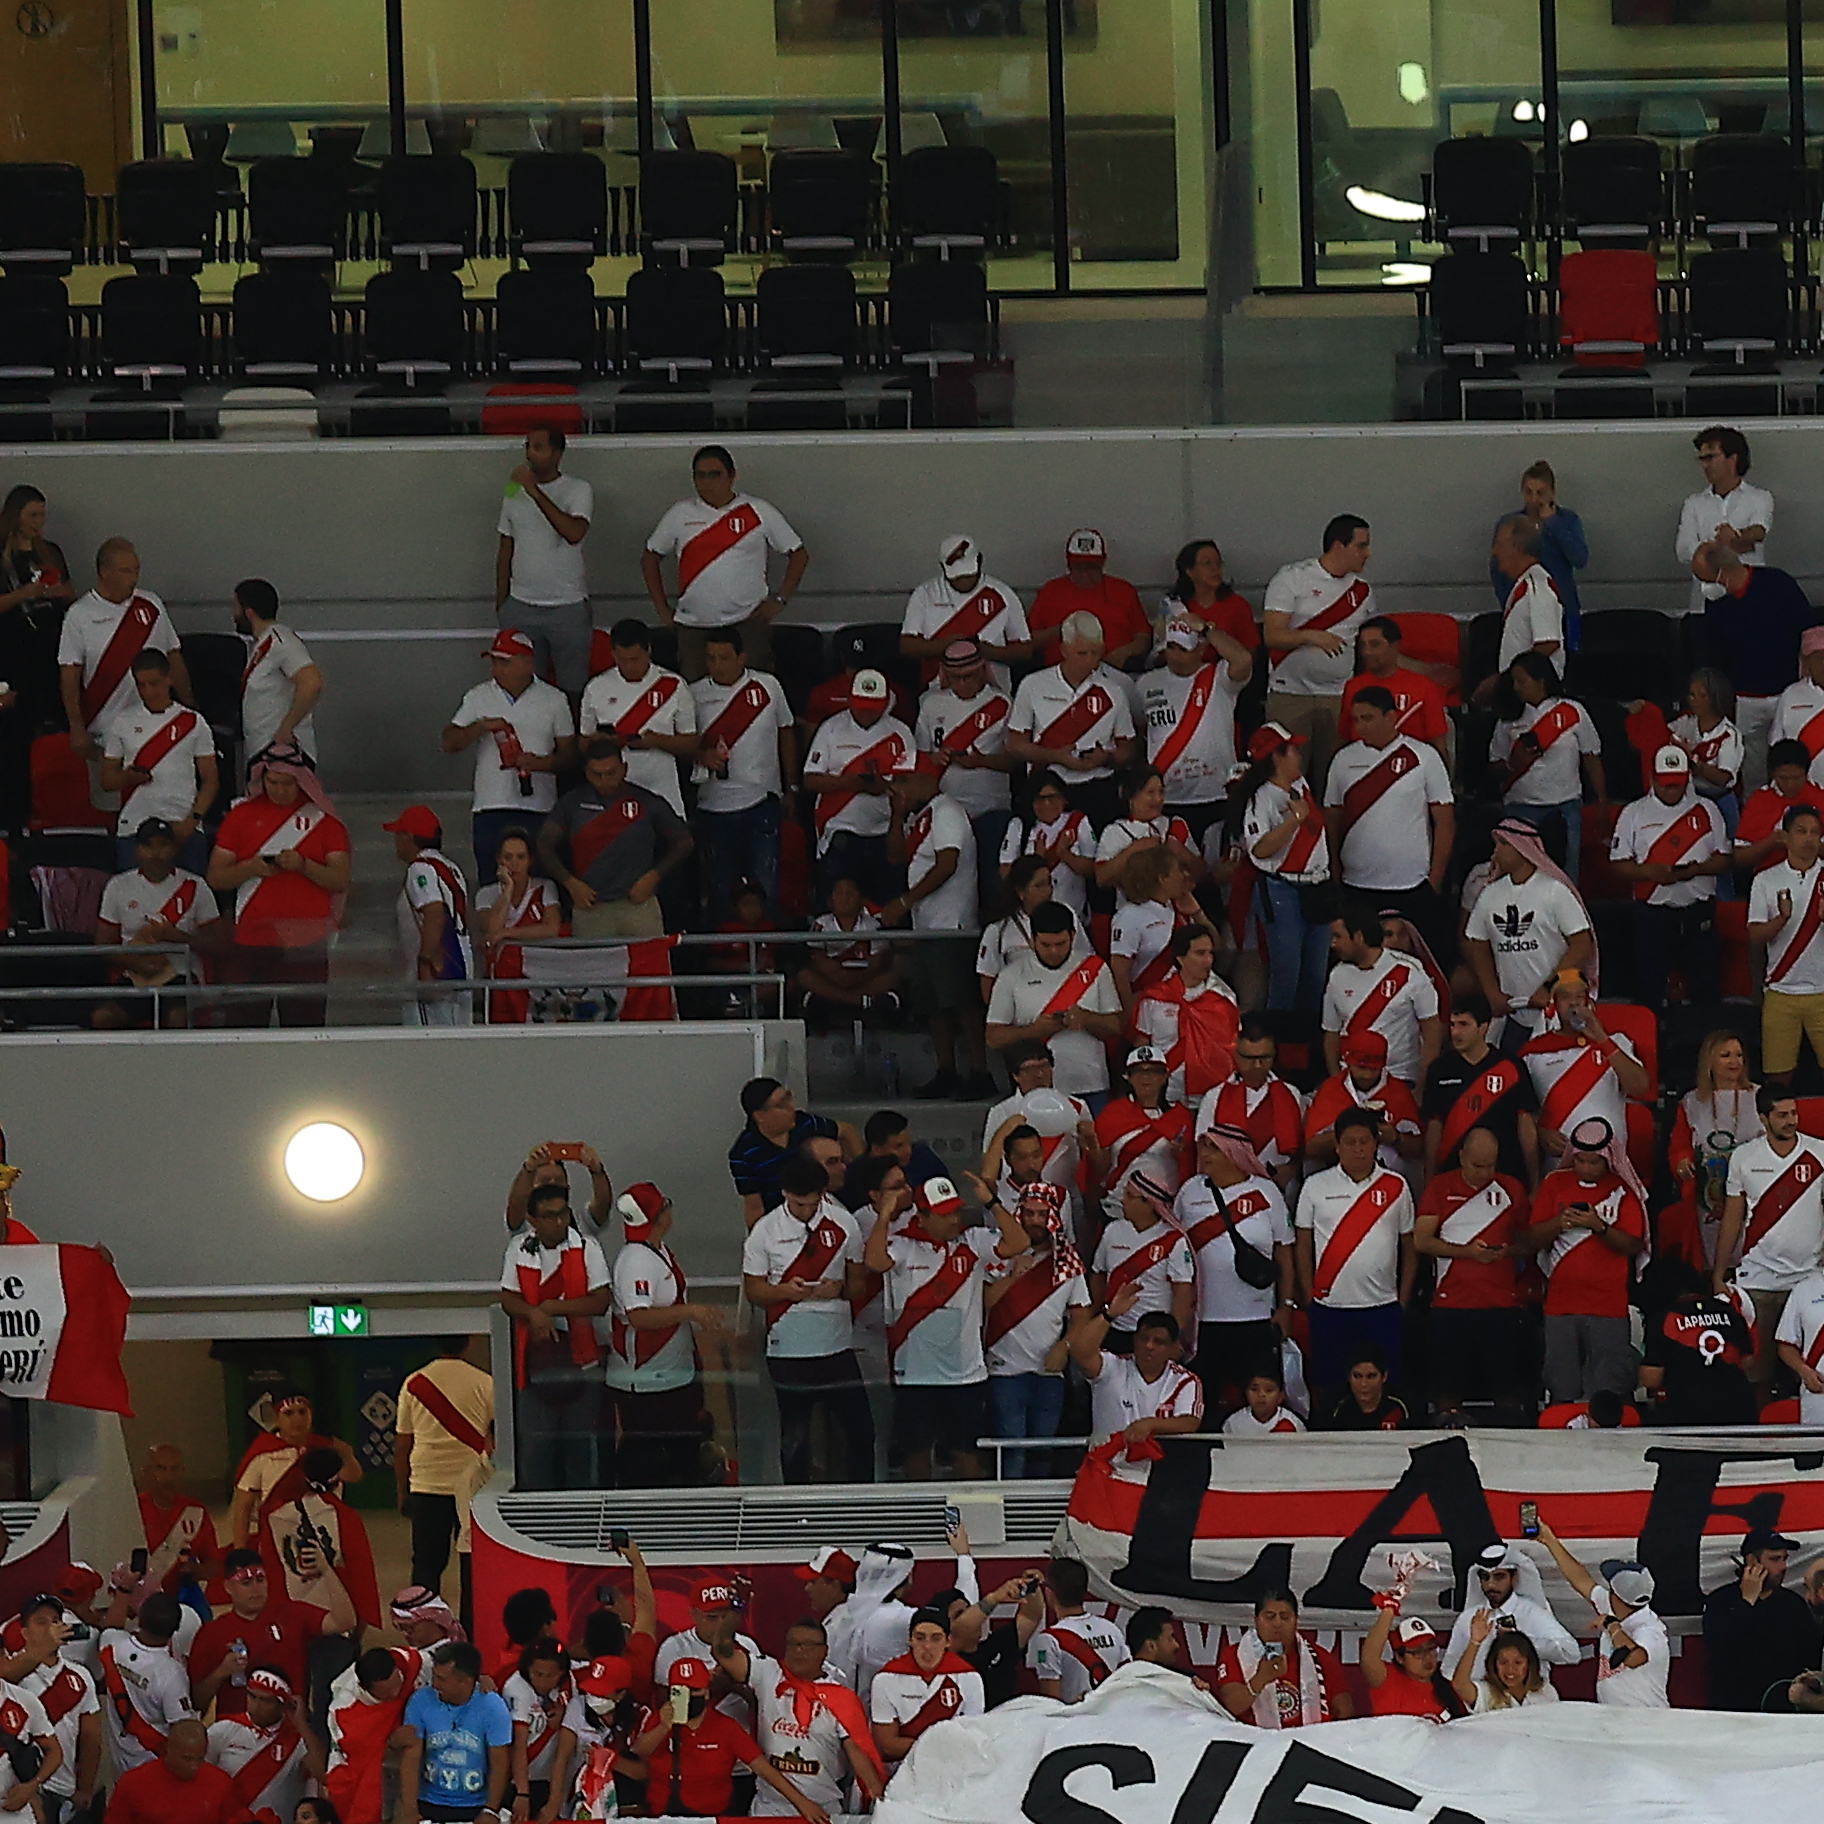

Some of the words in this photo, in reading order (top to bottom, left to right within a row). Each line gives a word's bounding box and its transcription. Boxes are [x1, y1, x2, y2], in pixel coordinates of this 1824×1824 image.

[1497, 938, 1539, 953] adidas
[1676, 1314, 1732, 1332] LAPADULA
[1698, 1330, 1726, 1366] 9
[1112, 1436, 1500, 1614] LA
